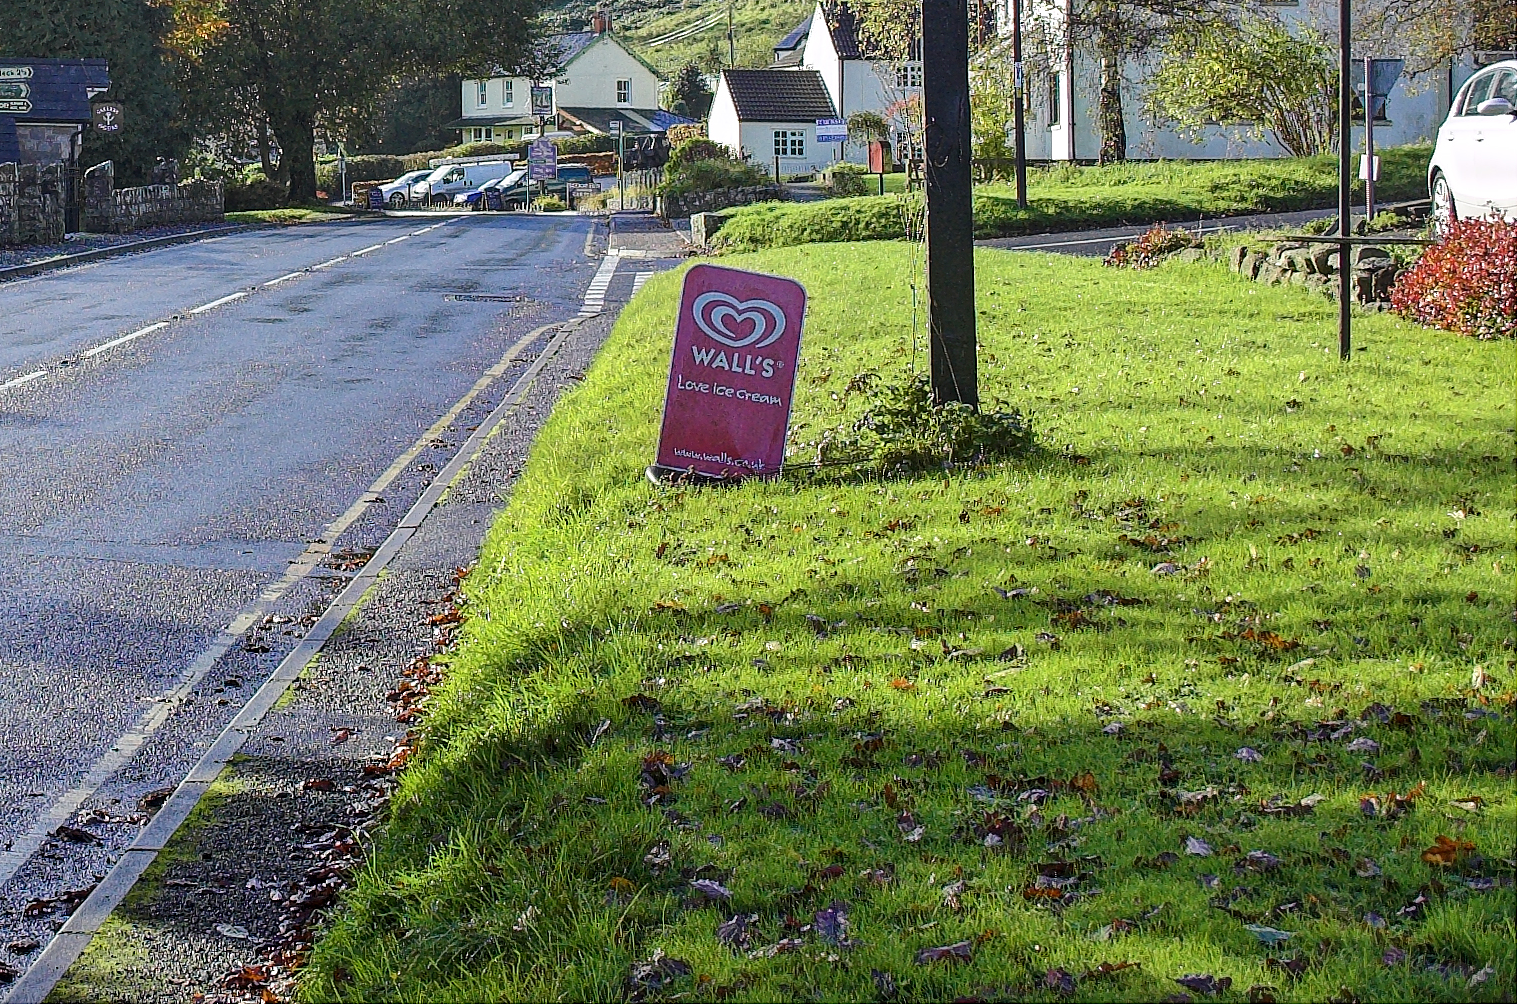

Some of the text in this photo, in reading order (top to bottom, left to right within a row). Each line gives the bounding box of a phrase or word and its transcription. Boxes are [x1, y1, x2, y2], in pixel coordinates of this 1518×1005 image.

[692, 345, 775, 378] WALL'S
[677, 374, 710, 393] Love
[713, 382, 733, 397] Ice
